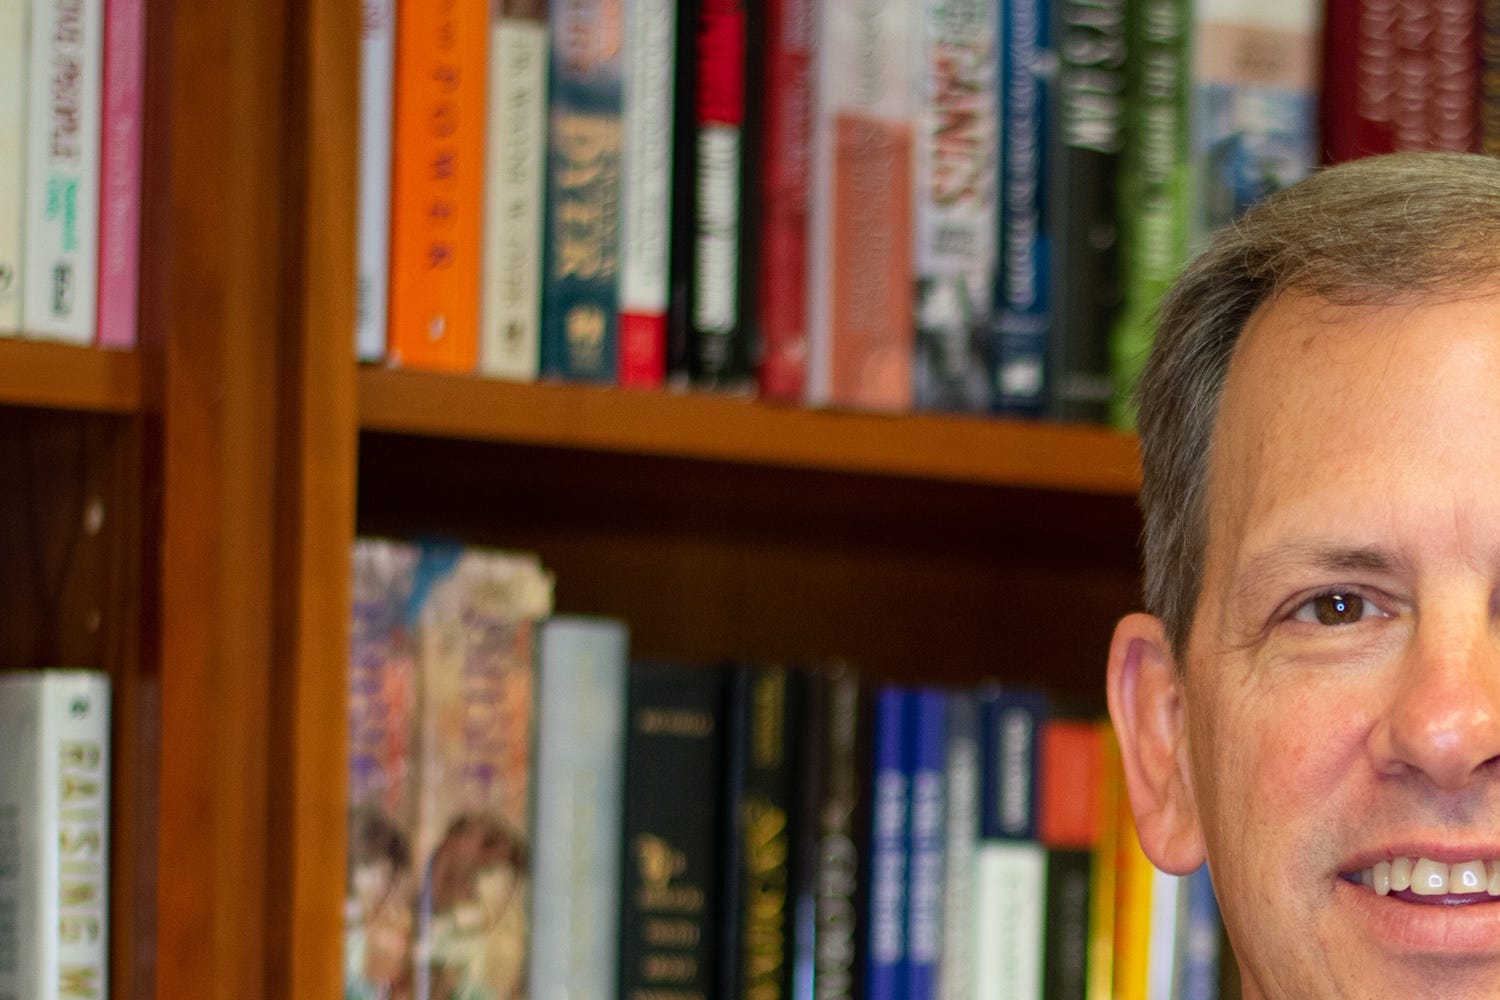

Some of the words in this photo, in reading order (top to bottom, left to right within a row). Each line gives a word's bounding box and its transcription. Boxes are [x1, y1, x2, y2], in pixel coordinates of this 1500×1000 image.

[427, 62, 462, 270] POWER
[556, 115, 618, 281] DYER
[58, 741, 100, 944] RAISING
